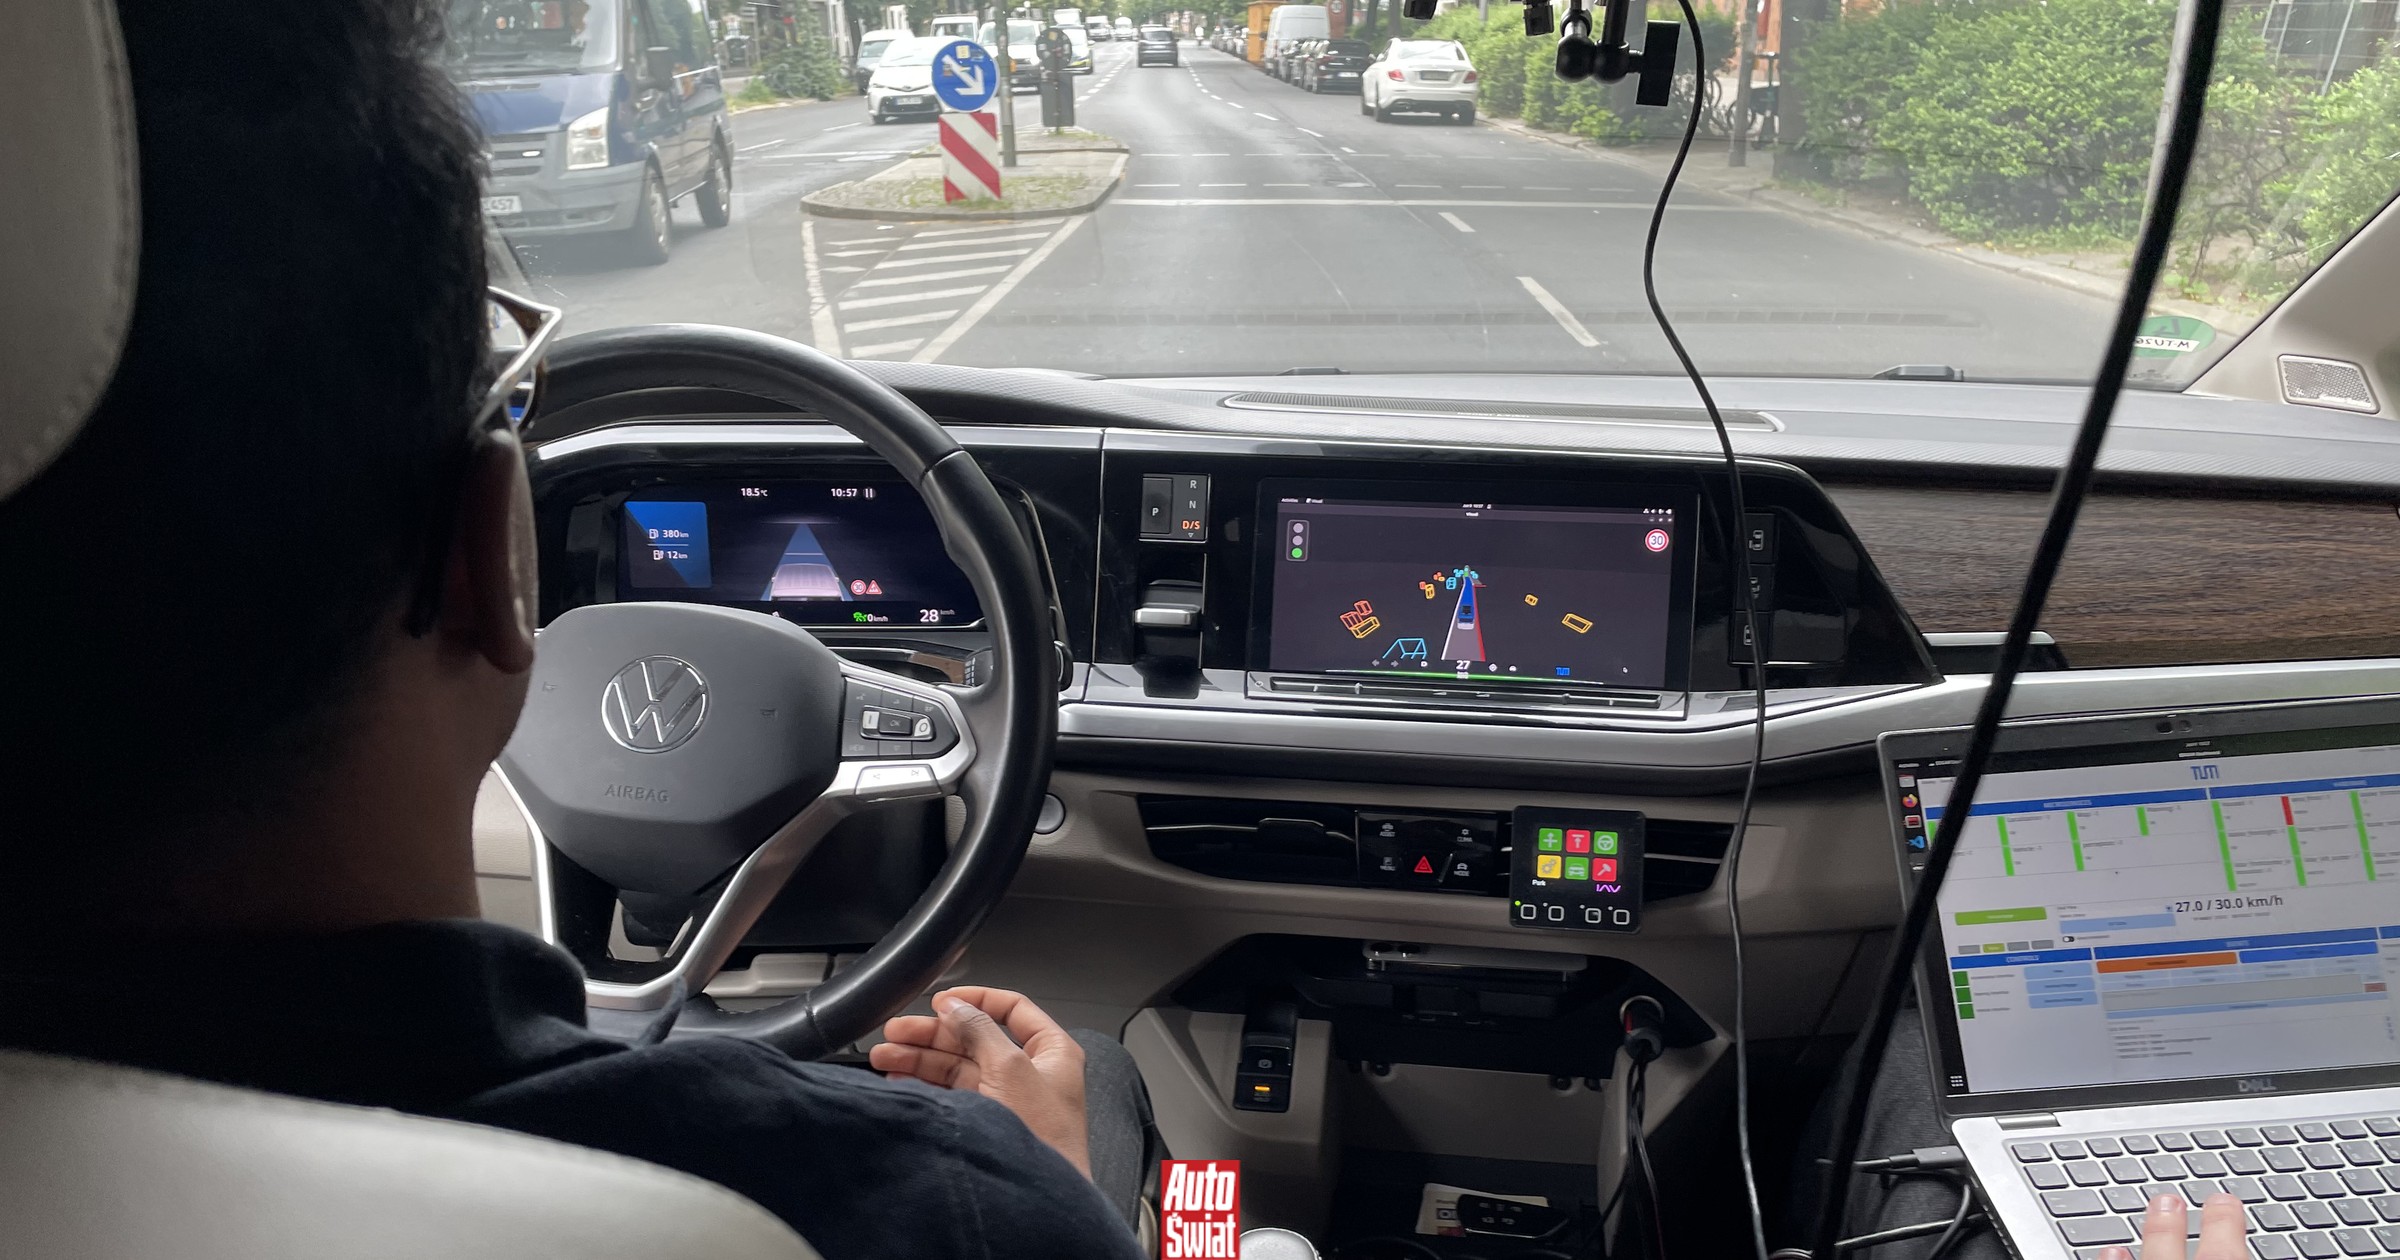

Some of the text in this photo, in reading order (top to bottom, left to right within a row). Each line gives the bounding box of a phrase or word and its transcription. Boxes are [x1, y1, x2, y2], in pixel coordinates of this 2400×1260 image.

[1190, 480, 1197, 489] R
[830, 488, 858, 497] 10:57
[1189, 501, 1197, 509] N
[1152, 508, 1159, 516] P
[1182, 520, 1201, 530] D/S
[1650, 536, 1664, 546] 30
[919, 609, 939, 622] 28
[1456, 660, 1471, 670] 27
[604, 784, 670, 802] AIRBAG
[2175, 901, 2203, 913] 27.0
[2215, 898, 2243, 910] 30.0
[2246, 895, 2283, 908] km/h
[2238, 1078, 2277, 1092] DELL
